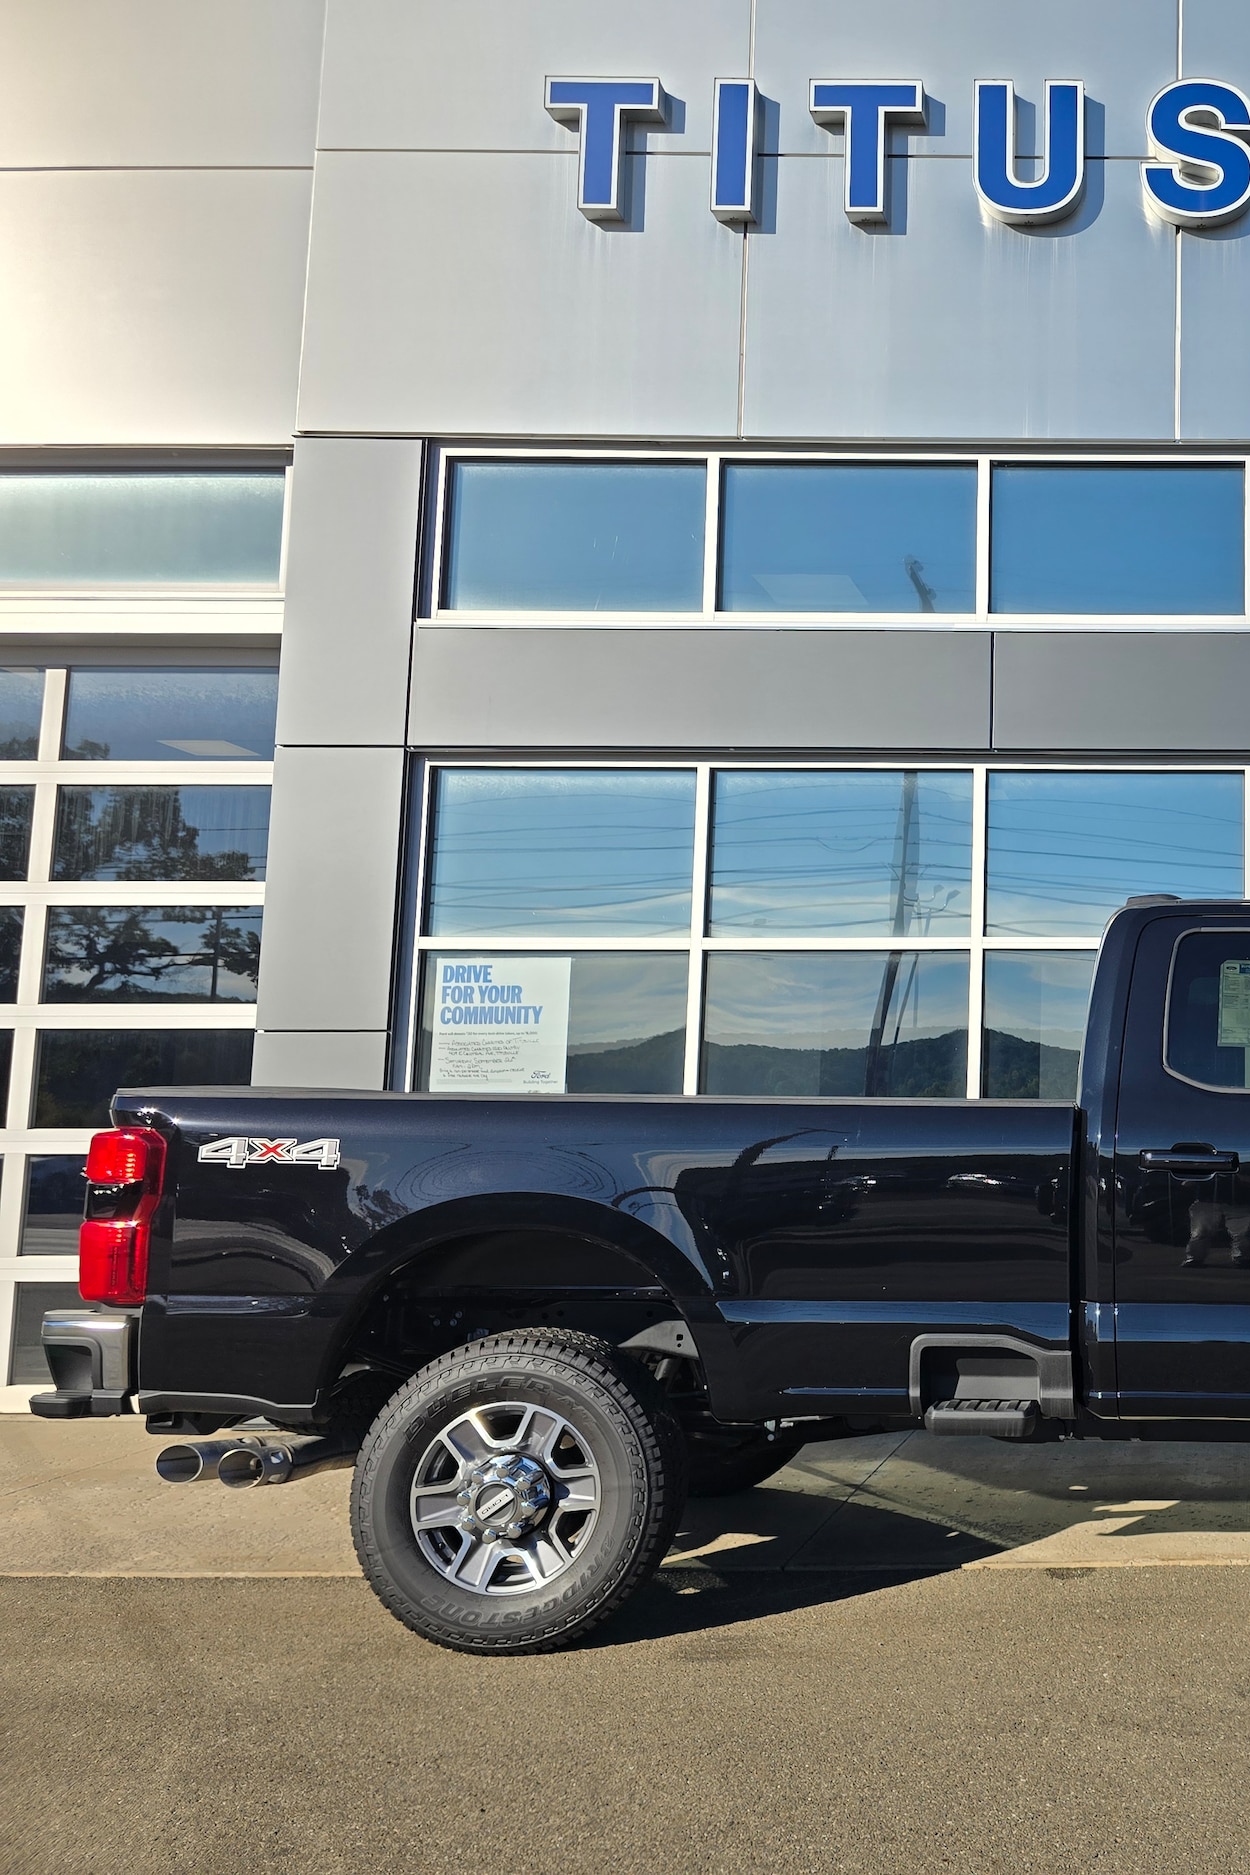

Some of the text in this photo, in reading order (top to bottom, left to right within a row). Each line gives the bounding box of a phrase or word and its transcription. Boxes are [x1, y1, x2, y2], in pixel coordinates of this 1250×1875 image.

[443, 965, 493, 983] DRIVE
[441, 985, 523, 1004] FOR YOUR
[440, 1006, 543, 1025] COMMUNITY
[530, 1070, 551, 1079] Ford
[403, 1373, 554, 1444] DUELER
[423, 1529, 617, 1629] BRIDGESTONE
